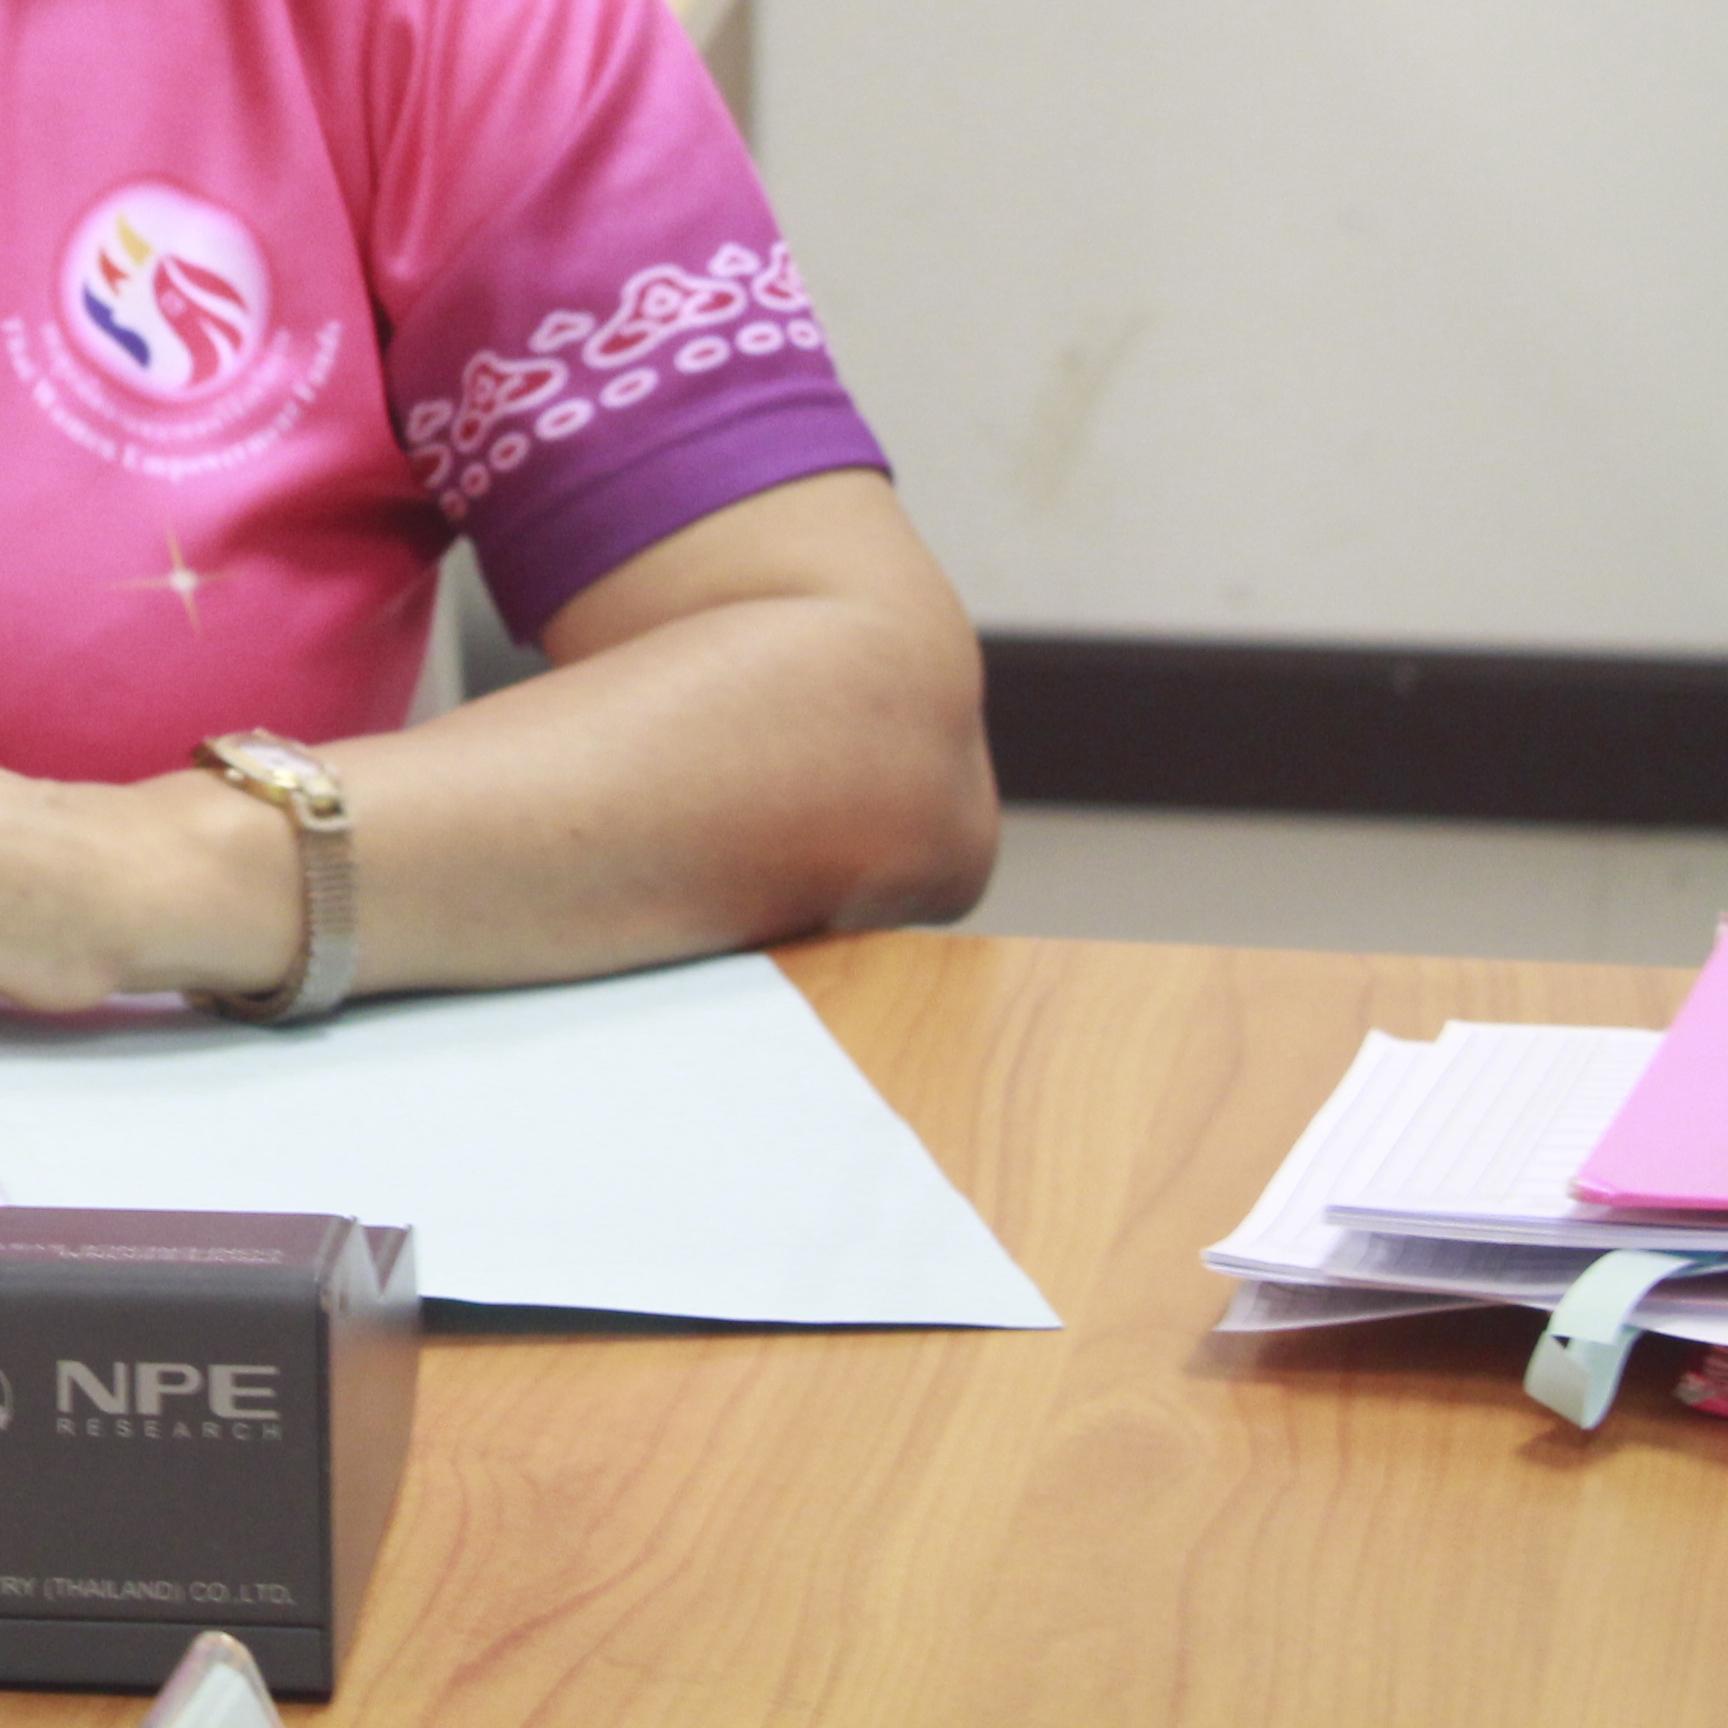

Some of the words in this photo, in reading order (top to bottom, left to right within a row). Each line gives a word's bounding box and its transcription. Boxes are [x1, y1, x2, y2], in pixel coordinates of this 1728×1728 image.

[55, 1358, 282, 1420] NPE
[55, 1417, 283, 1442] RESEARCH
[43, 1576, 187, 1604] (THAILAND)
